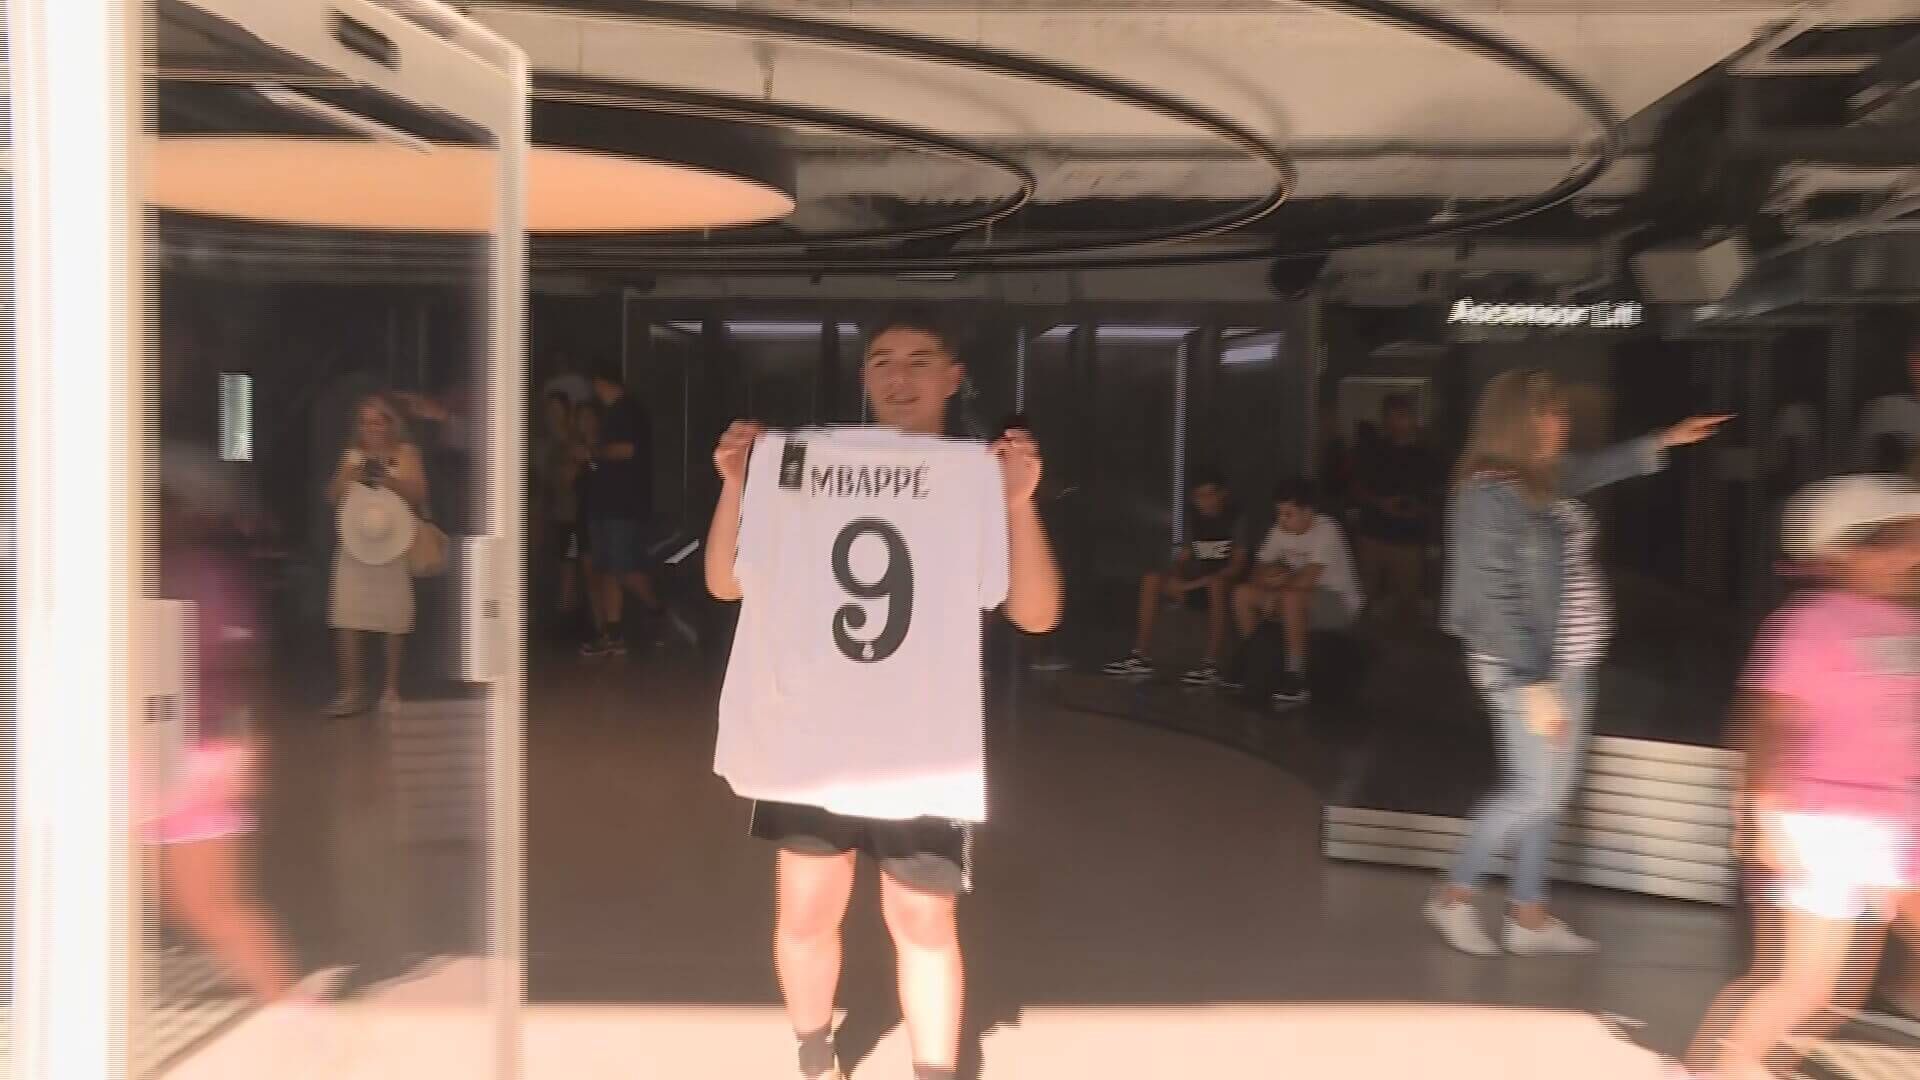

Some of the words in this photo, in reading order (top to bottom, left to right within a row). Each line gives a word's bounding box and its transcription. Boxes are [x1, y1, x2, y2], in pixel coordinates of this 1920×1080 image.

[1447, 297, 1589, 325] Ascensor
[810, 460, 930, 498] MBAPPÉ
[831, 517, 914, 663] 9
